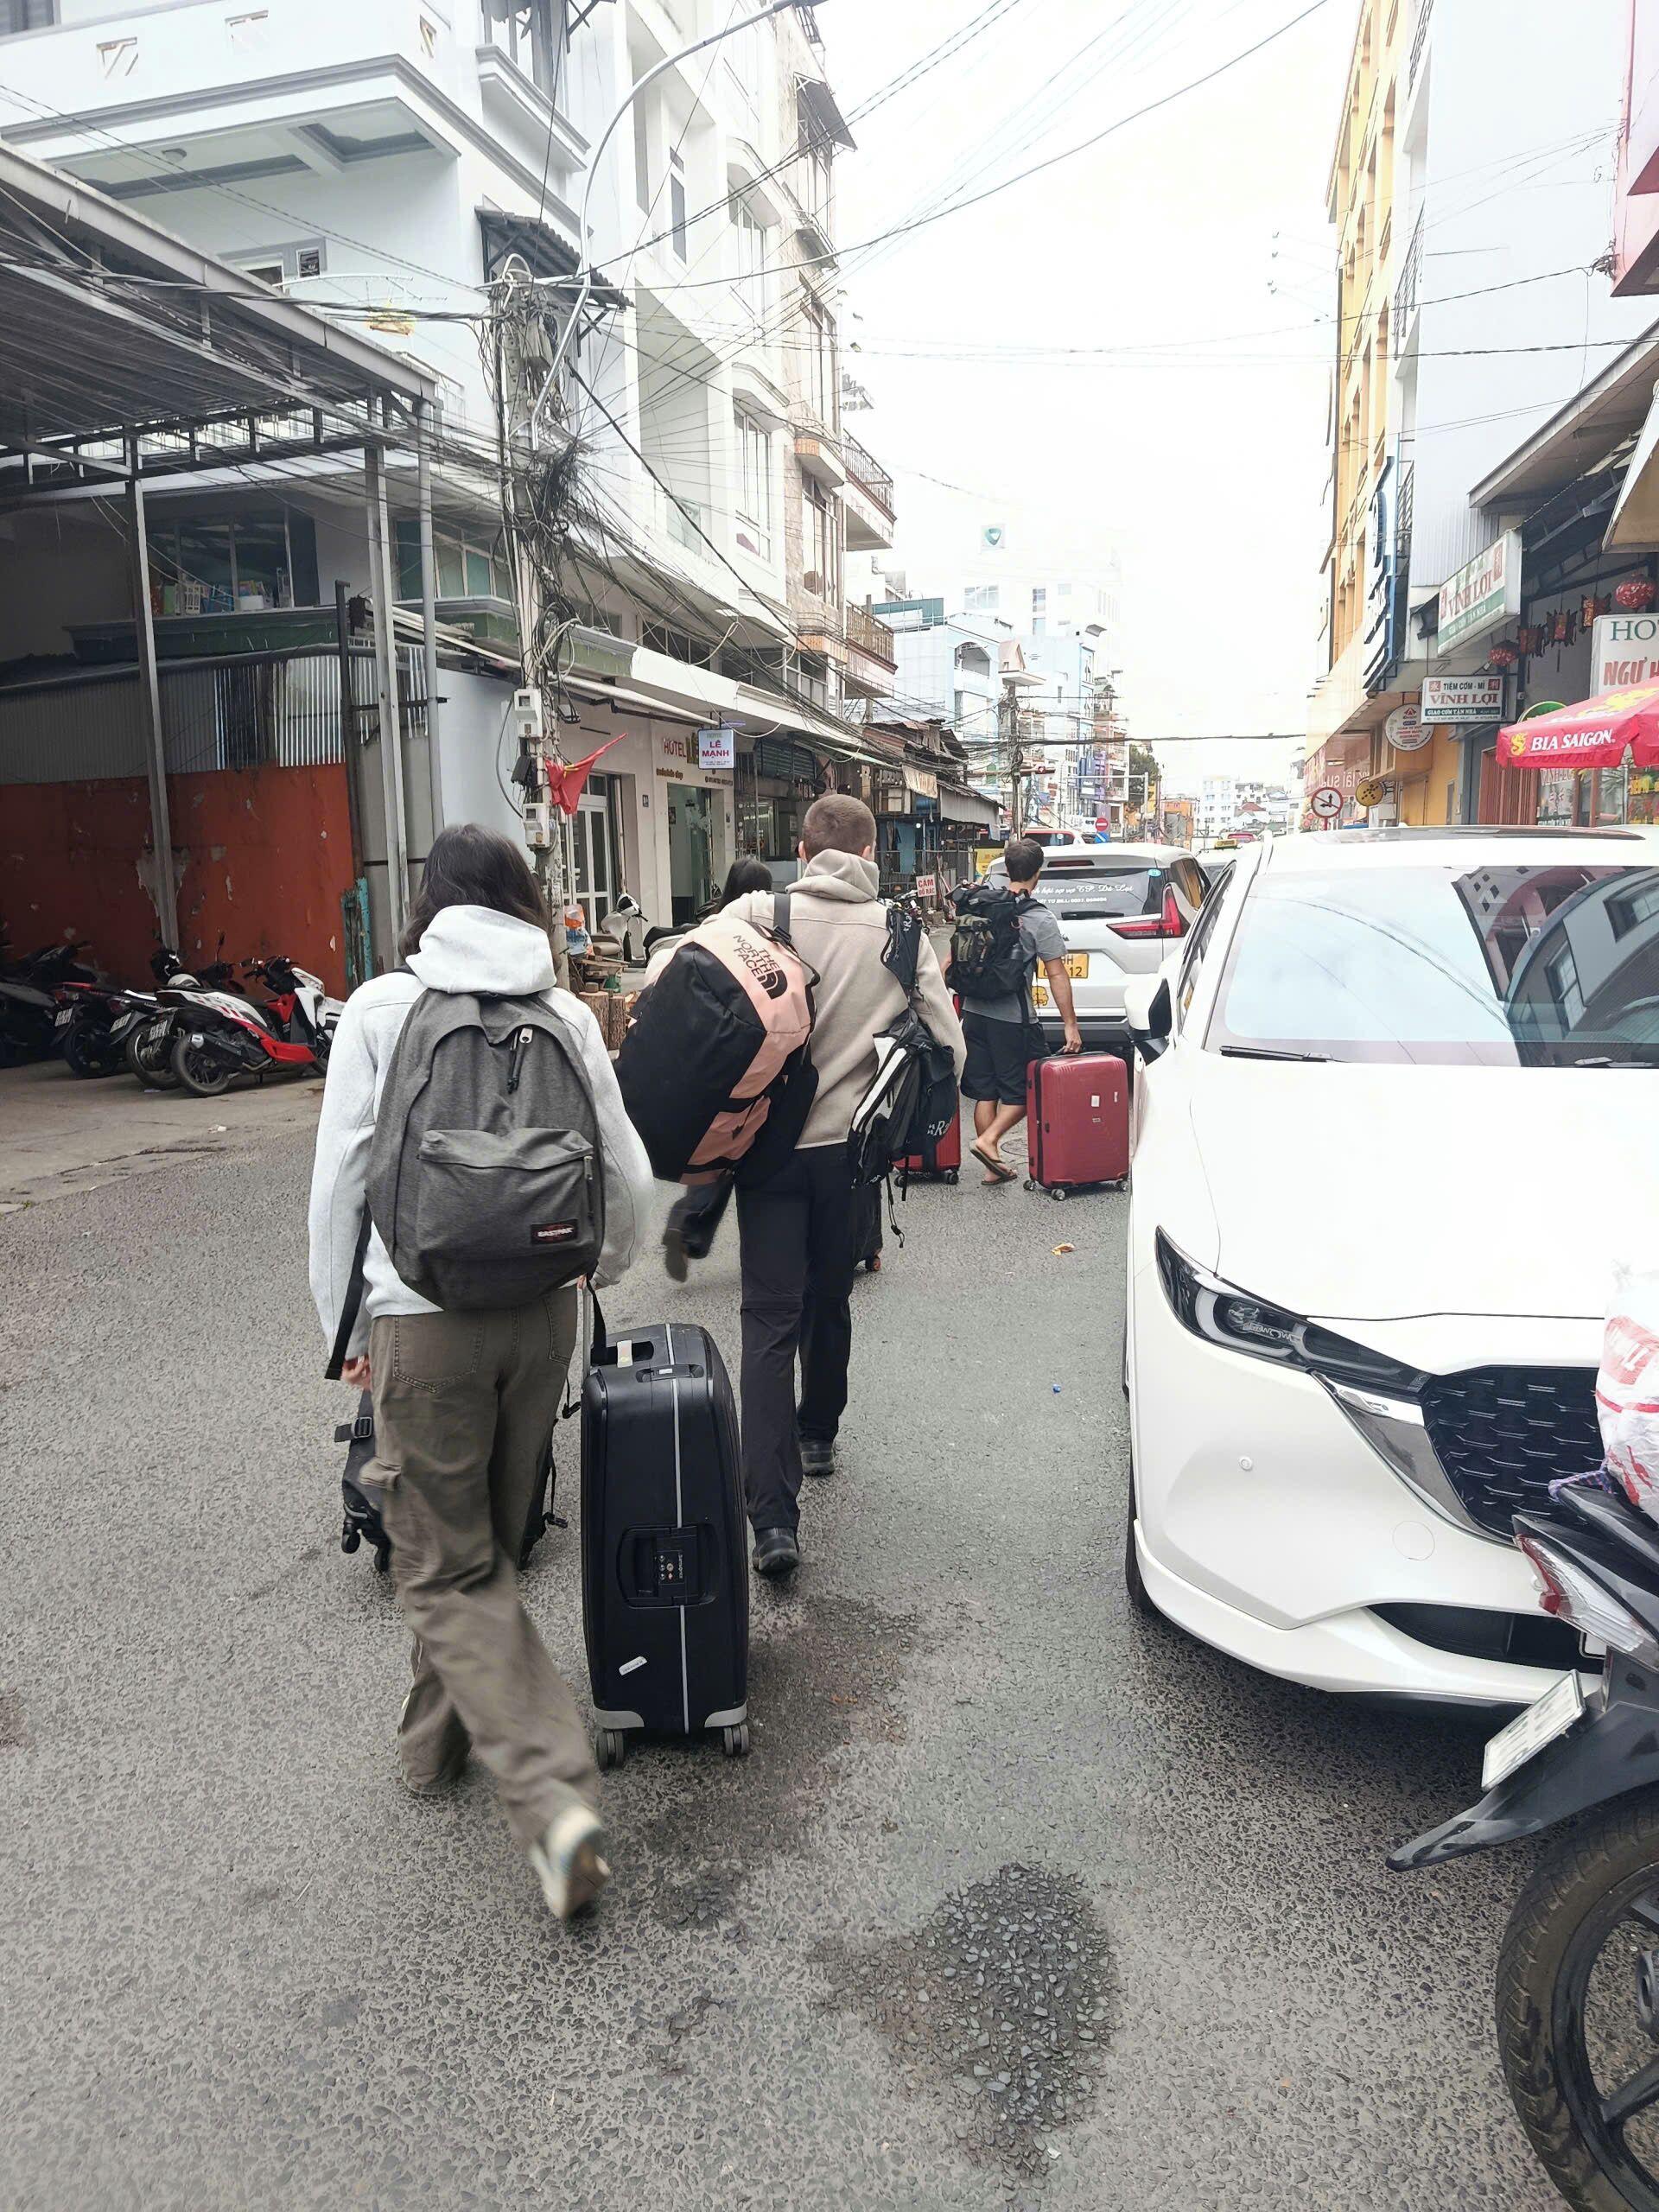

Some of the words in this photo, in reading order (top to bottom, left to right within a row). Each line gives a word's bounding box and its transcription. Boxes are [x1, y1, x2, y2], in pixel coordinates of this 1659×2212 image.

[1610, 619, 1659, 641] HO
[1459, 681, 1472, 690] CƠM
[1430, 693, 1468, 705] VĨNH
[1471, 693, 1499, 705] LỢI
[664, 741, 686, 758] HOTEL
[709, 740, 721, 748] LÊ
[1530, 736, 1558, 751] BIA
[702, 750, 729, 759] MẠNH
[733, 935, 772, 973] NORTH
[734, 947, 763, 977] FACE
[759, 948, 780, 970] THE
